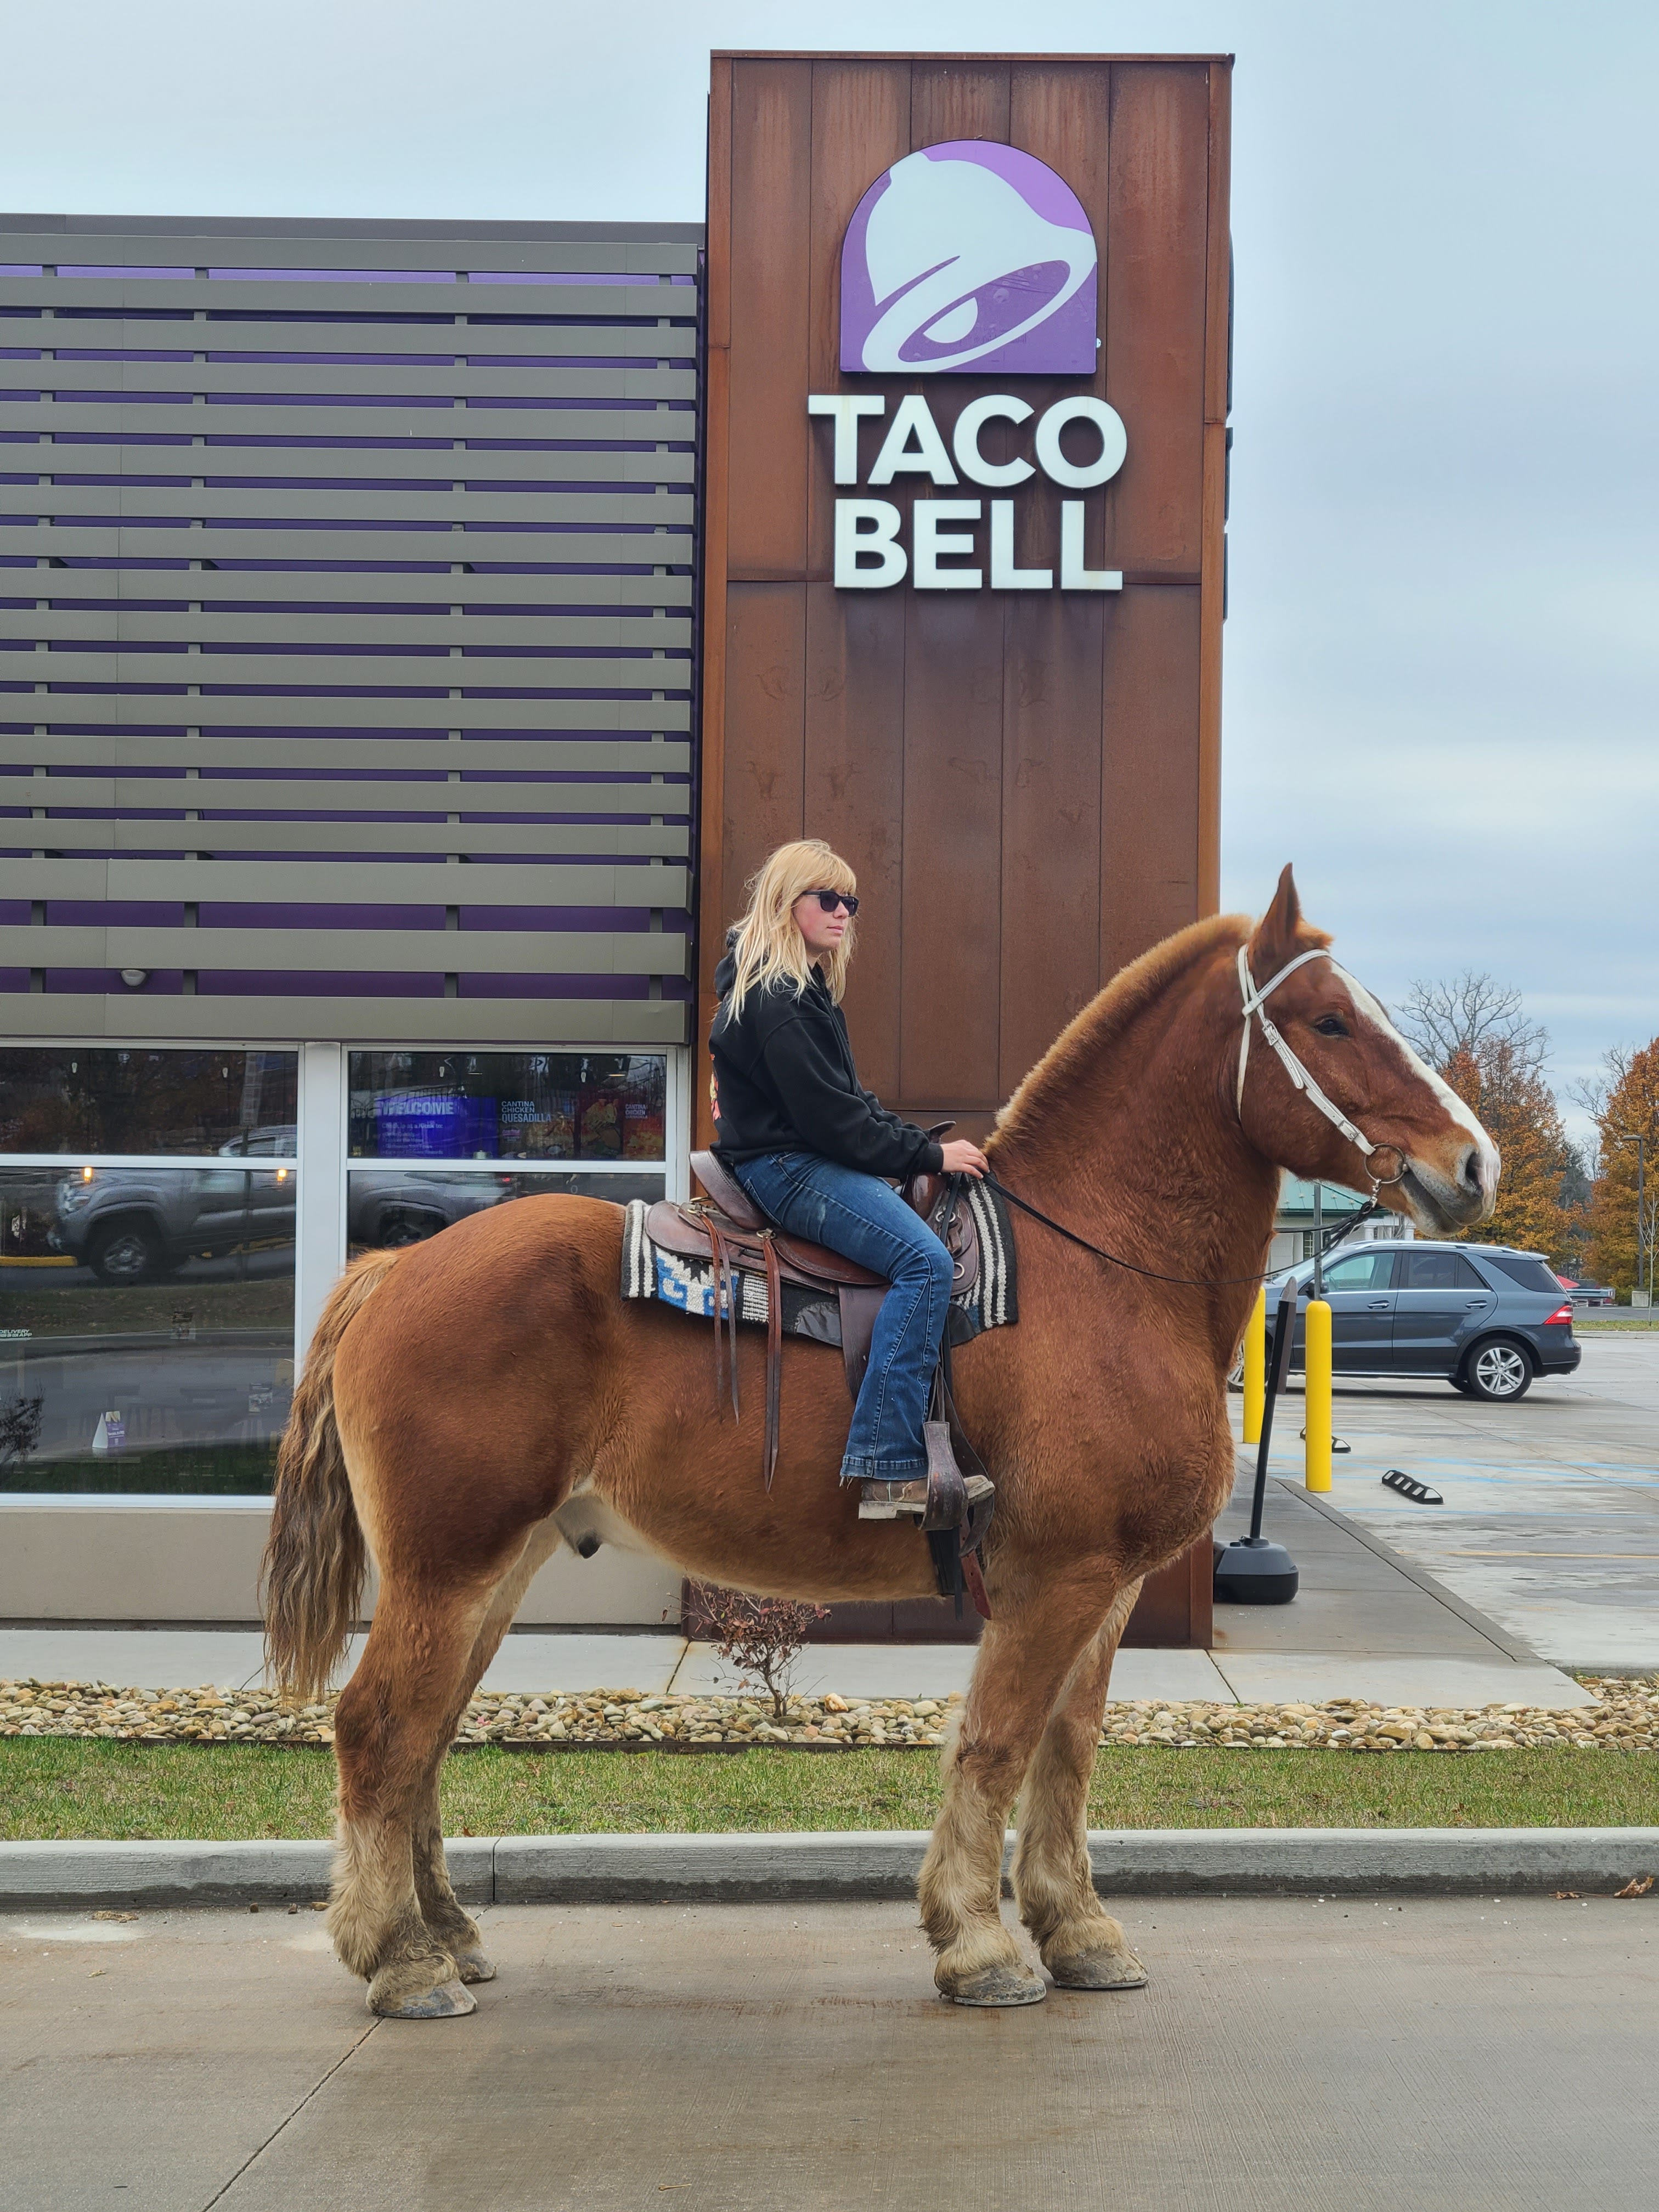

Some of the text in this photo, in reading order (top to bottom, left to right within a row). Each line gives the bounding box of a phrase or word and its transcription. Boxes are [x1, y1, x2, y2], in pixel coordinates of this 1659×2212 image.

[808, 394, 1127, 489] TACO
[834, 499, 1123, 591] BELL
[382, 1102, 454, 1115] WELCOME
[502, 1113, 551, 1124] QUESADILLA
